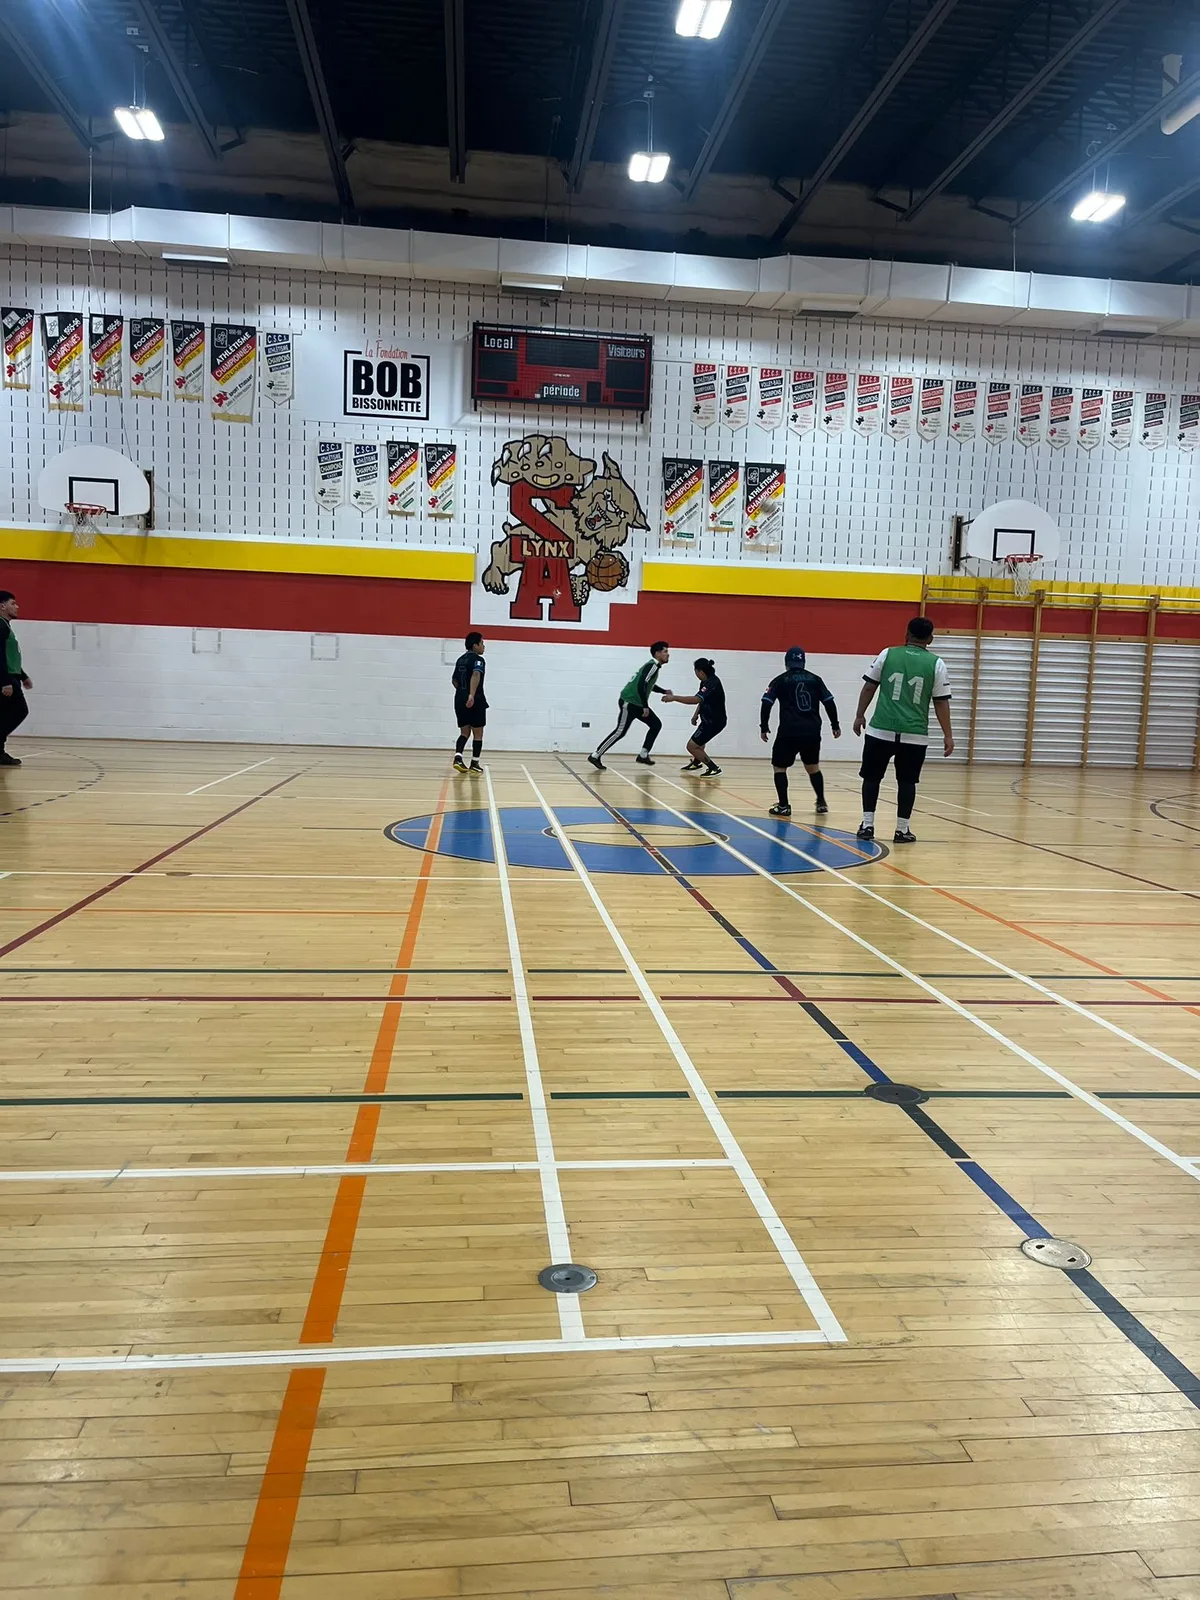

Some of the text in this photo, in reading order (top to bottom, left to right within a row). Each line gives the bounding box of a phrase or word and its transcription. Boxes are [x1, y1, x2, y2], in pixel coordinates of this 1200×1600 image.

[133, 333, 162, 361] CHAMPIONS
[134, 324, 162, 350] FOOTBALL
[365, 339, 408, 360] La Fondation
[484, 335, 513, 350] Local
[216, 344, 252, 378] CHAMPIONNES
[608, 344, 646, 359] Visiteurs
[352, 359, 422, 399] BOB
[544, 383, 580, 398] période
[352, 397, 421, 412] BISSONNETTE
[666, 465, 698, 496] BASKET-BALL
[666, 475, 698, 508] CHAMPIONS
[711, 468, 736, 492] BASKET-BALL
[711, 476, 736, 502] CHAMPIONS
[748, 480, 780, 512] CHAMPIONS
[522, 540, 571, 558] LYNX
[795, 682, 812, 712] 6
[888, 672, 924, 704] 11
